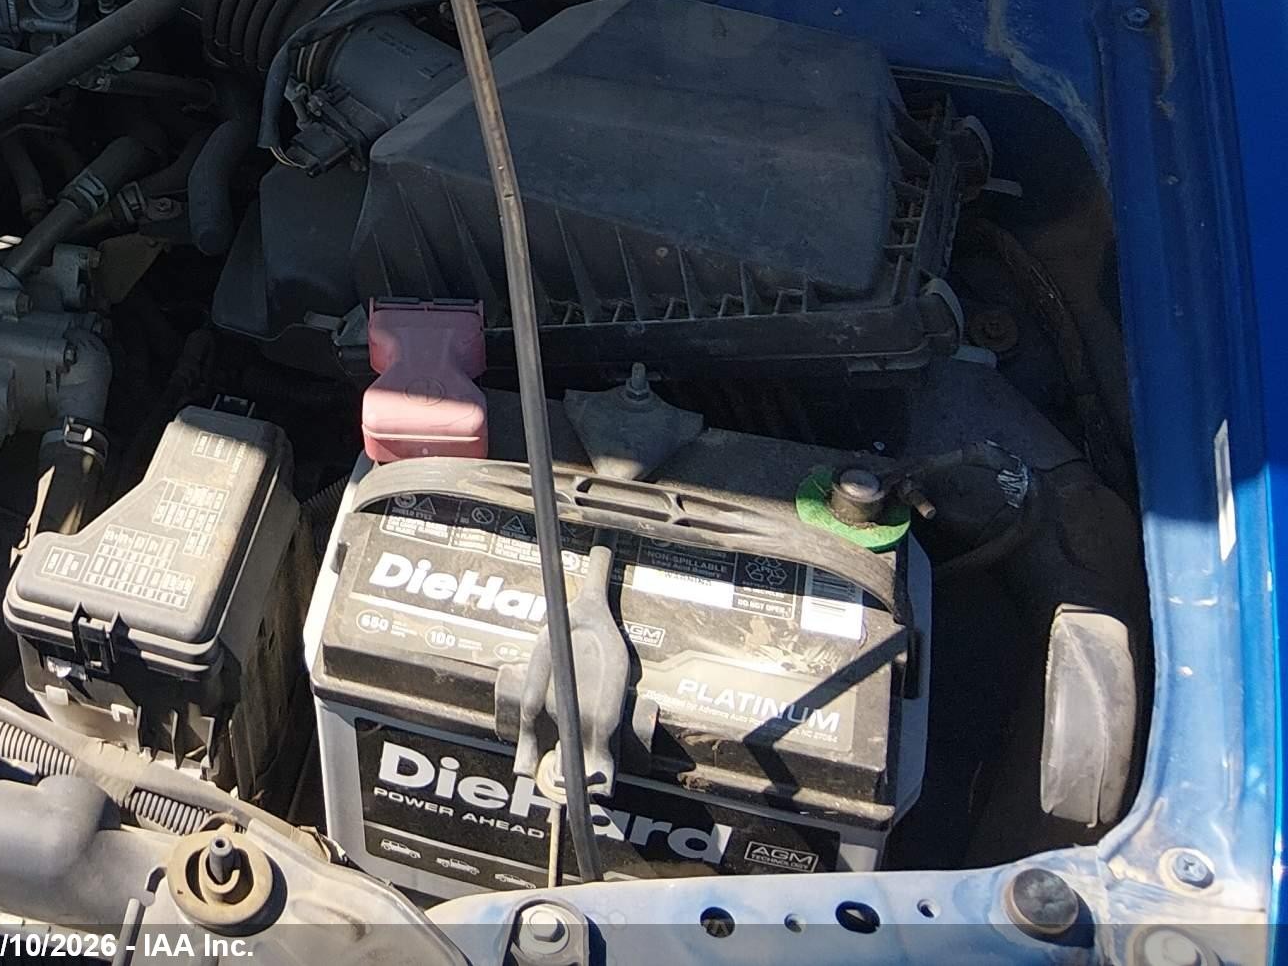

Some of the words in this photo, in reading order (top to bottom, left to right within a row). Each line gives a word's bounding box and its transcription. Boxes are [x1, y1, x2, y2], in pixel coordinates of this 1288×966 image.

[361, 611, 390, 633] 650
[431, 628, 456, 648] 100
[677, 677, 840, 733] PLATINUM
[373, 786, 455, 818] POWER
[462, 811, 546, 840] AHEAD
[751, 854, 809, 870] TECHNOLOGY
[752, 846, 813, 866] AGM
